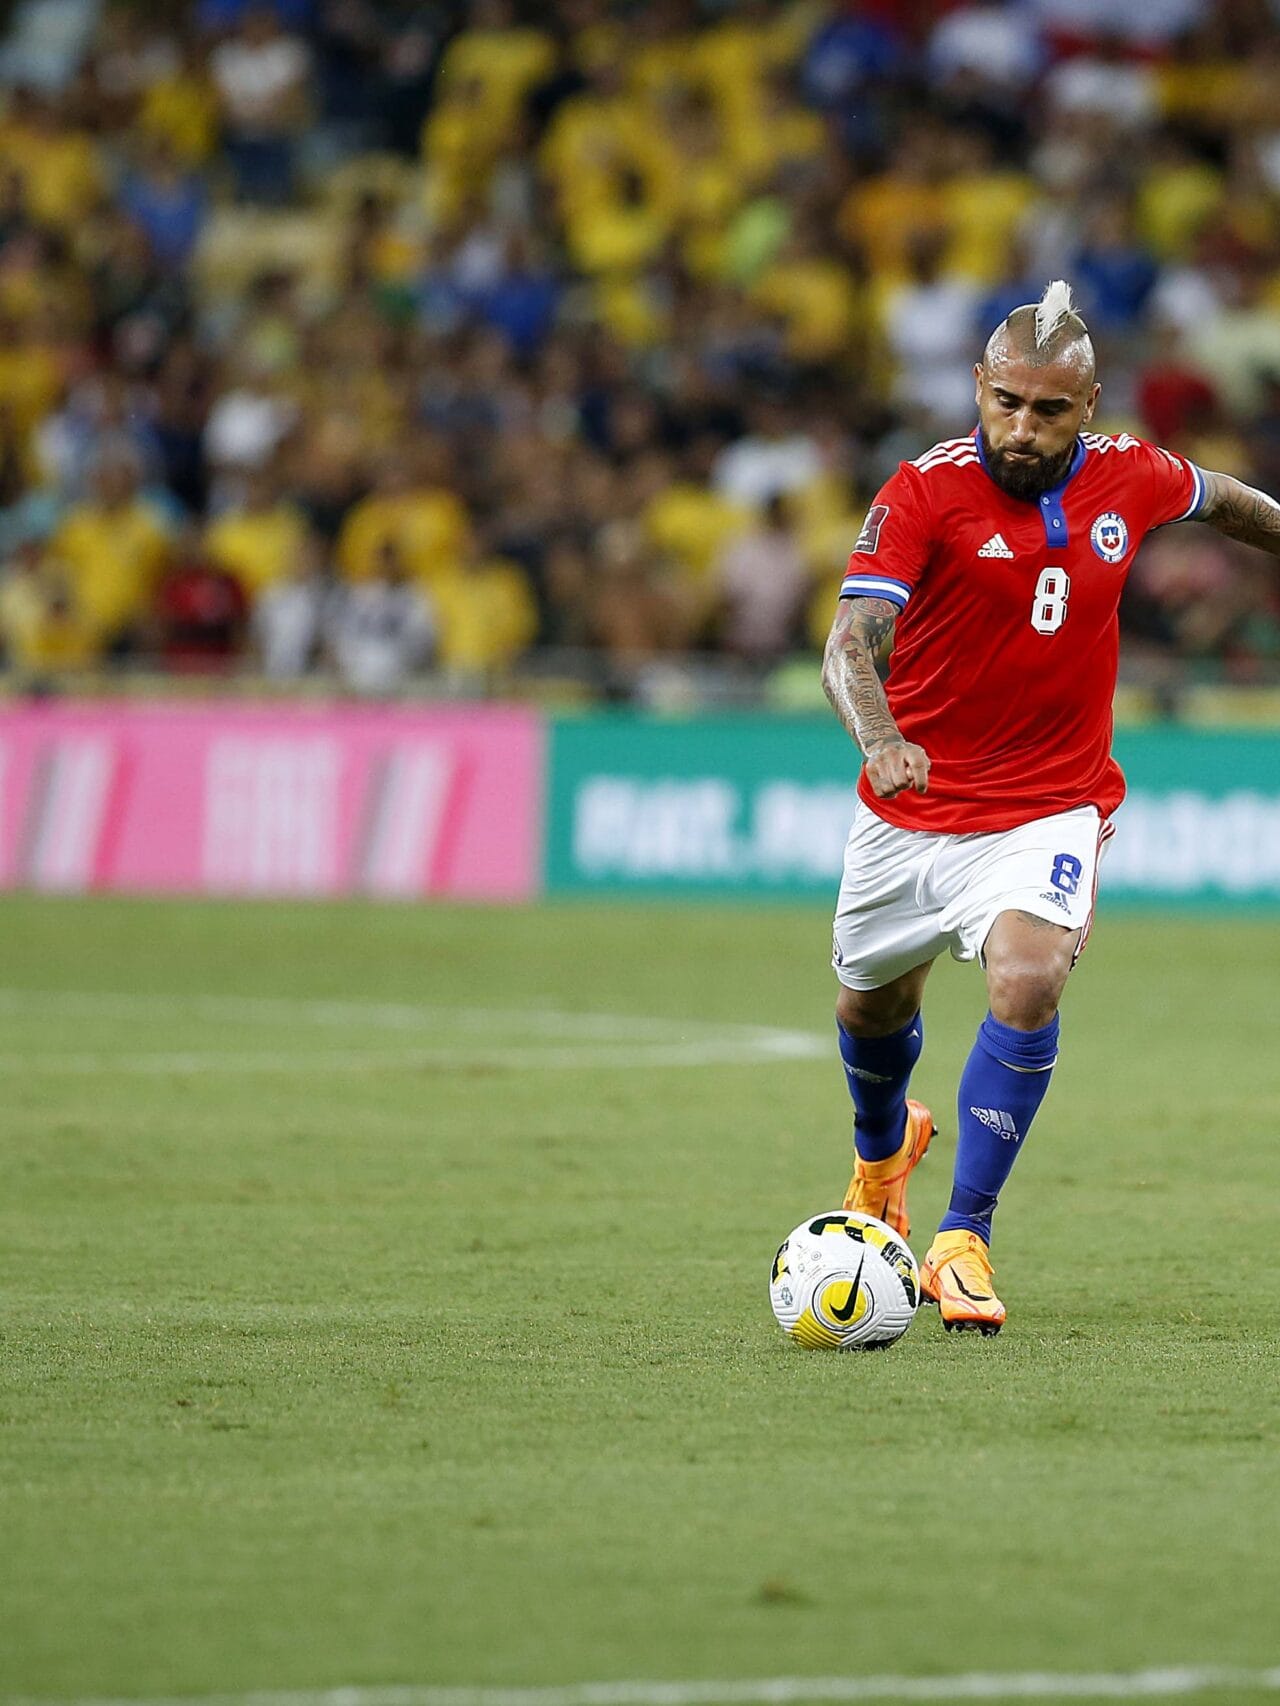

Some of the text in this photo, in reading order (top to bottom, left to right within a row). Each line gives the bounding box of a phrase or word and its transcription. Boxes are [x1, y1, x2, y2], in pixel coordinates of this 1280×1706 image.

[977, 549, 1015, 560] adidas
[1030, 567, 1071, 636] 8
[1050, 852, 1082, 895] 8
